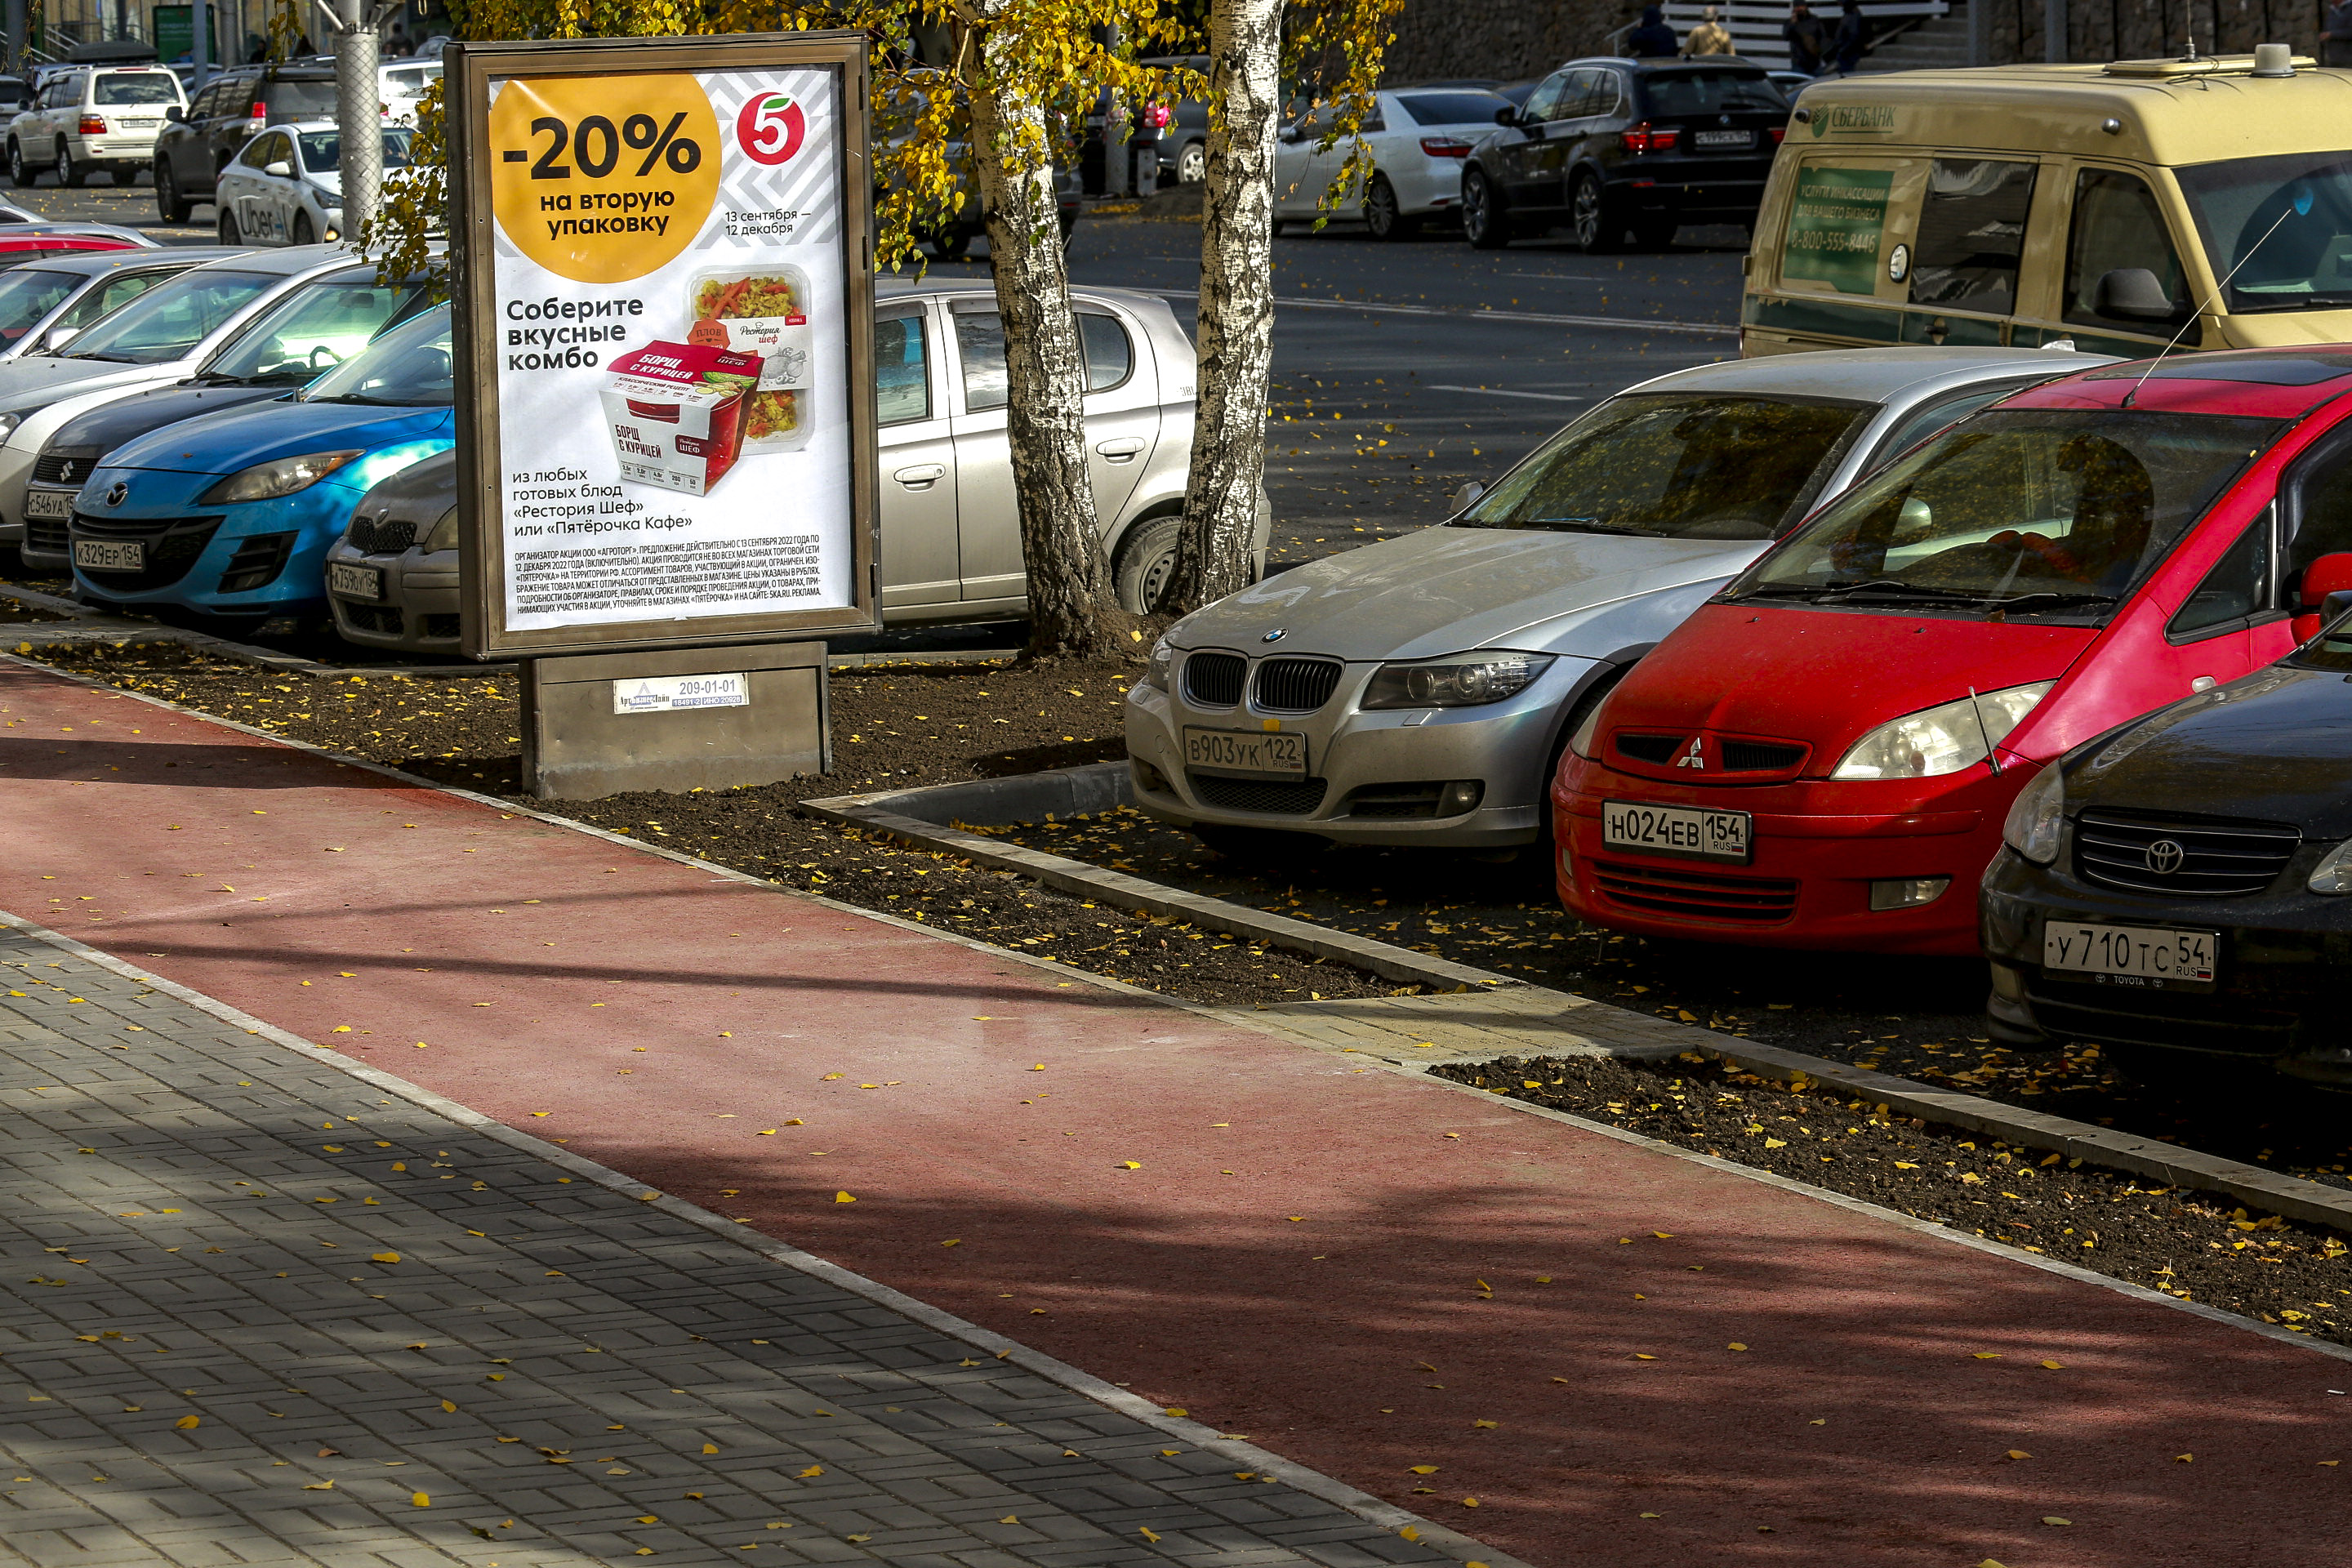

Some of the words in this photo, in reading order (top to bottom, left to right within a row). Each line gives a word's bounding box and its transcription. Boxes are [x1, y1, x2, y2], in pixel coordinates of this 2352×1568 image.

[1832, 106, 1896, 127] СБЕРБАНК
[502, 112, 702, 180] -20%
[540, 194, 572, 212] на
[580, 190, 675, 217] вторую
[1802, 185, 1830, 198] УСЛУГИ
[1830, 186, 1886, 202] ИНКАССАЦИИ
[238, 199, 274, 238] Uber
[725, 212, 737, 222] 13
[740, 208, 797, 222] сентября
[1797, 204, 1813, 217] ДЛЯ
[1813, 205, 1845, 219] ВАШЕГО
[1846, 207, 1880, 221] БИЗНЕСА
[546, 215, 670, 241] упаковку
[725, 225, 737, 235] 12
[742, 222, 793, 236] декабря
[1792, 229, 1876, 253] 8-800-555-8446
[506, 296, 644, 323] Соберите
[508, 324, 626, 350] вкусные
[696, 328, 722, 337] ПЛОВ
[740, 325, 781, 336] Рестория
[759, 334, 778, 345] шеф
[509, 346, 599, 371] комбо
[639, 354, 683, 369] БОРЩ
[630, 363, 640, 372] С
[639, 365, 693, 380] КУРИЦЕЙ
[615, 425, 640, 442] БОРЩ
[618, 439, 625, 451] С
[625, 441, 662, 459] КУРИЦЕЙ
[679, 444, 700, 453] ШЕФ
[513, 472, 530, 483] из
[533, 466, 588, 483] любых
[513, 488, 577, 501] готовых
[581, 483, 623, 498] блюд
[514, 503, 595, 519] «Рестория
[599, 499, 644, 516] Шеф»
[514, 524, 542, 537] или
[547, 517, 640, 537] «Пятёрочка
[644, 514, 693, 531] Кафе»
[122, 545, 140, 561] 154
[514, 550, 559, 560] ОРГАНИЗАТОР
[559, 549, 580, 559] АКЦИИ
[582, 548, 595, 557] ООО
[597, 545, 637, 555] «АГРОТОРГ».
[639, 542, 684, 555] ПРЕДЛОЖЕНИЕ
[686, 537, 735, 551] ДЕЙСТВИТЕЛЬНО
[737, 539, 740, 547] С
[741, 538, 746, 547] 13
[747, 537, 776, 546] СЕНТЯБРЯ
[777, 536, 792, 545] 2022
[794, 535, 808, 546] ГОДА
[810, 534, 819, 543] ПО
[514, 563, 521, 571] 12
[523, 561, 550, 572] ДЕКАБРЯ
[552, 560, 567, 569] 2022
[568, 559, 583, 569] ГОДА
[585, 556, 640, 568] (ВКЛЮЧИТЕЛЬНО).
[641, 555, 662, 565] АКЦИЯ
[663, 552, 702, 564] ПРОВОДИТСЯ
[703, 551, 710, 560] НЕ
[712, 551, 720, 559] ВО
[721, 550, 735, 559] ВСЕХ
[736, 548, 773, 558] МАГАЗИНАХ
[773, 545, 804, 556] ТОРГОВОЙ
[805, 545, 819, 554] СЕТИ
[516, 572, 559, 582] «ПЯТЕРОЧКА»
[560, 571, 569, 579] НА
[570, 568, 608, 579] ТЕРРИТОРИИ
[609, 568, 621, 577] РФ.
[621, 565, 663, 576] АССОРТИМЕНТ
[665, 564, 693, 574] ТОВАРОВ,
[694, 559, 740, 572] УЧАСТВУЮЩИЙ
[742, 560, 745, 568] В
[746, 559, 768, 569] АКЦИИ,
[768, 557, 805, 567] ОГРАНИЧЕН.
[805, 556, 819, 564] ИЗО-
[516, 582, 550, 593] БРАЖЕНИЕ
[550, 581, 575, 590] ТОВАРА
[575, 580, 598, 589] МОЖЕТ
[599, 577, 637, 587] ОТЛИЧАТЬСЯ
[639, 577, 647, 586] ОТ
[648, 573, 702, 586] ПРЕДСТАВЛЕННЫХ
[704, 573, 708, 581] В
[709, 571, 742, 581] МАГАЗИНЕ.
[743, 570, 760, 580] ЦЕНЫ
[761, 568, 791, 578] УКАЗАНЫ
[792, 568, 795, 576] В
[795, 567, 820, 576] РУБЛЯХ.
[516, 593, 562, 604] ПОДРОБНОСТИ
[564, 592, 572, 600] ОБ
[572, 589, 619, 601] ОРГАНИЗАТОРЕ,
[621, 587, 654, 598] ПРАВИЛАХ,
[655, 586, 674, 595] СРОКЕ
[675, 586, 679, 594] И
[679, 584, 707, 595] ПОРЯДКЕ
[709, 581, 747, 593] ПРОВЕДЕНИЯ
[748, 580, 771, 590] АКЦИИ,
[771, 580, 776, 588] О
[777, 578, 805, 589] ТОВАРАХ,
[805, 577, 820, 586] ПРИ-
[518, 604, 555, 615] НИМАЮЩИХ
[555, 602, 583, 611] УЧАСТИЯ
[589, 600, 612, 611] АКЦИИ,
[612, 596, 647, 608] УТОЧНЯЙТЕ
[648, 598, 652, 606] В
[653, 595, 689, 605] МАГАЗИНАХ
[691, 591, 733, 604] «ПЯТЁРОЧКА»
[740, 592, 748, 600] НА
[748, 589, 768, 599] САЙТЕ:
[769, 590, 791, 599] 5KA.RU.
[792, 588, 821, 597] РЕКЛАМА.
[679, 679, 735, 695] 209-01-01
[673, 698, 701, 706] 18491-2
[1264, 737, 1297, 760] 122
[1272, 760, 1290, 768] RUS
[1705, 815, 1740, 842] 154
[1713, 840, 1731, 851] RUS
[2179, 936, 2204, 965] 54
[2114, 975, 2145, 987] TOYOTA
[2176, 965, 2197, 978] RUS
